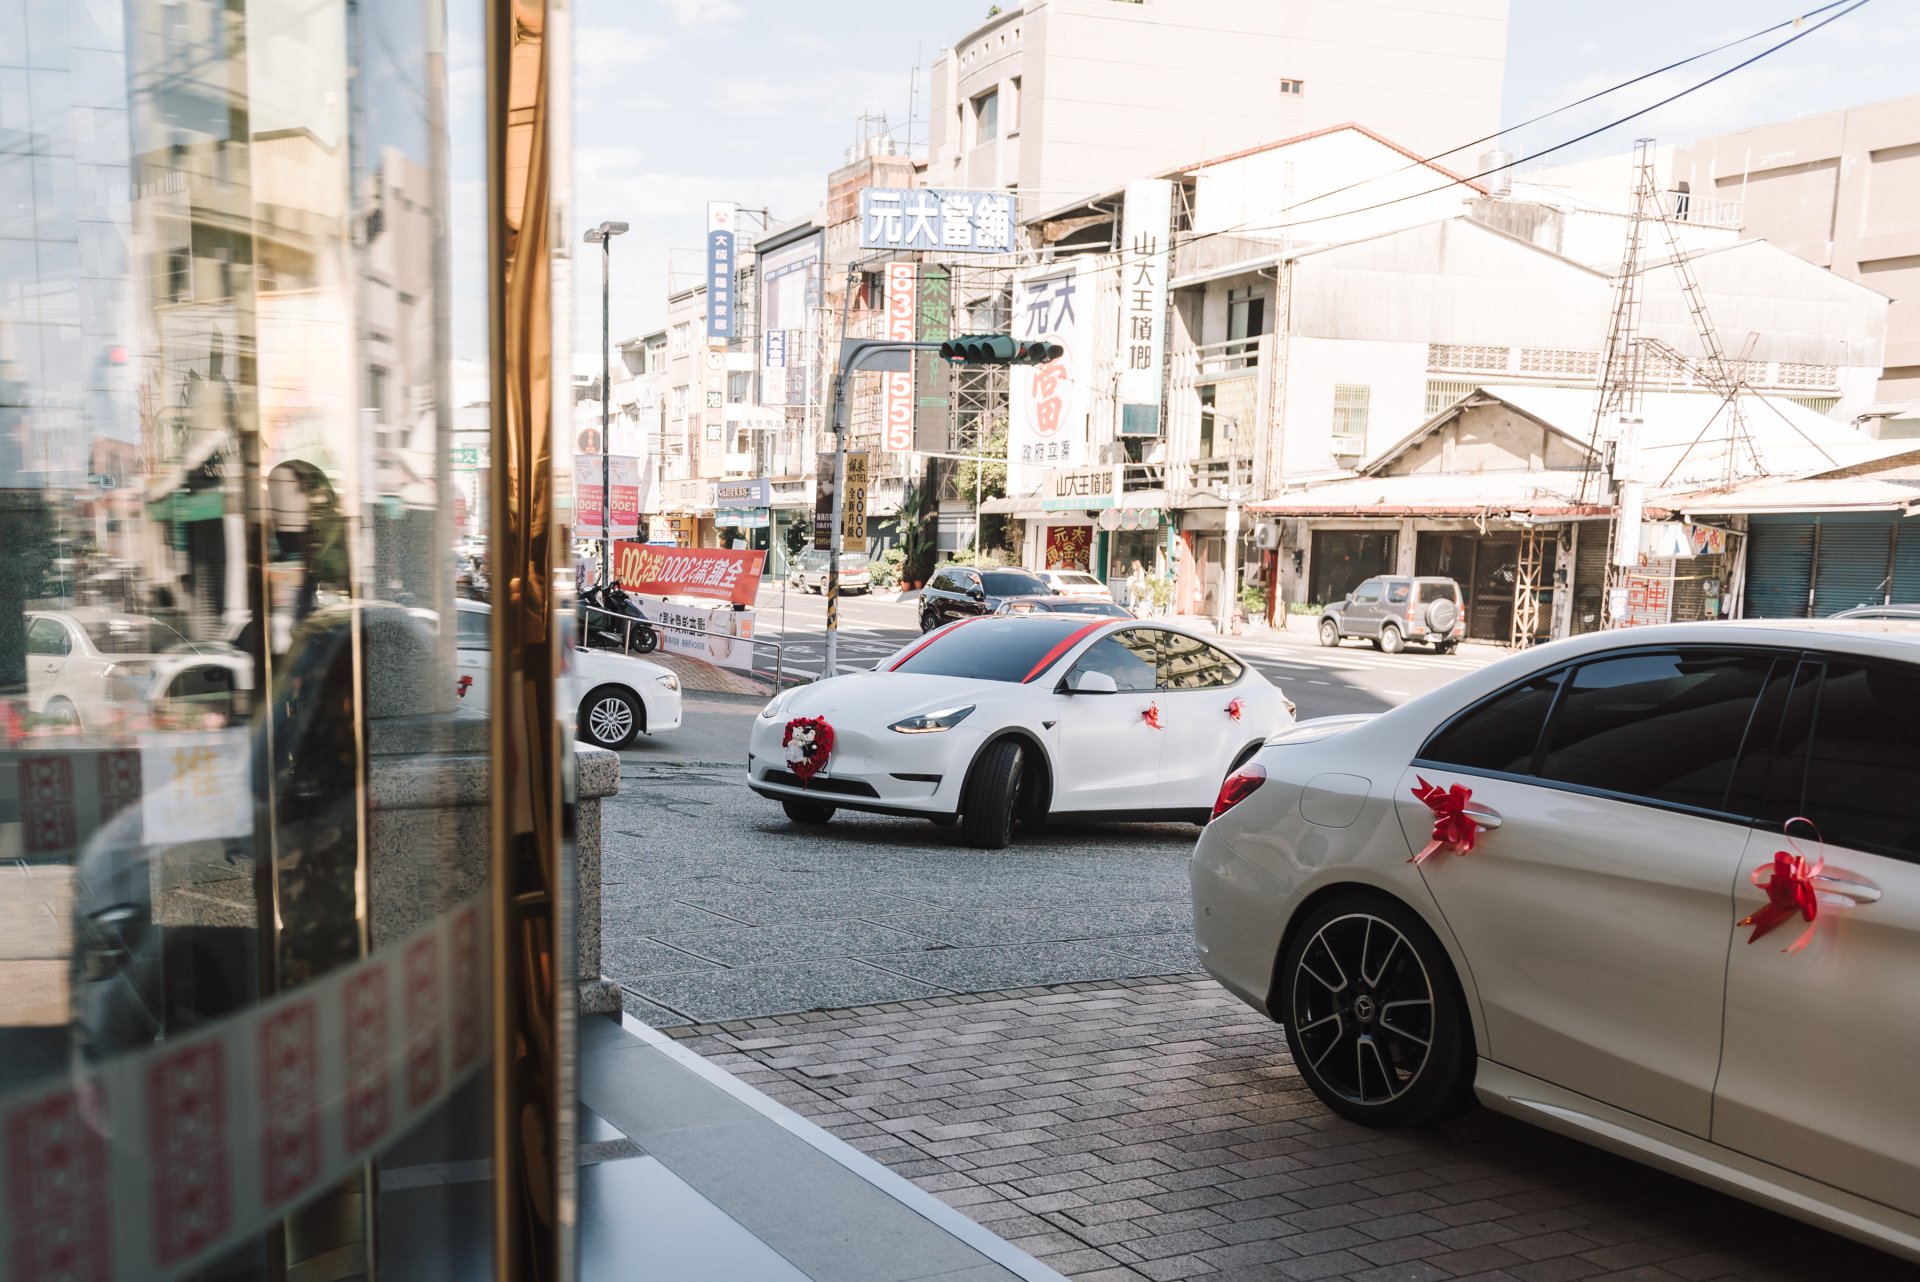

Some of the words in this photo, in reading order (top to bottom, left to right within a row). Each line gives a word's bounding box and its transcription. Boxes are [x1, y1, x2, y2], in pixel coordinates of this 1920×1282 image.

[869, 191, 1010, 247] 元大當舖
[1025, 274, 1077, 337] 元大
[1130, 230, 1156, 370] 山大王檳榔
[889, 266, 912, 449] 835555
[1021, 440, 1071, 463] 政府立案
[1056, 471, 1113, 497] 山大王檳榔
